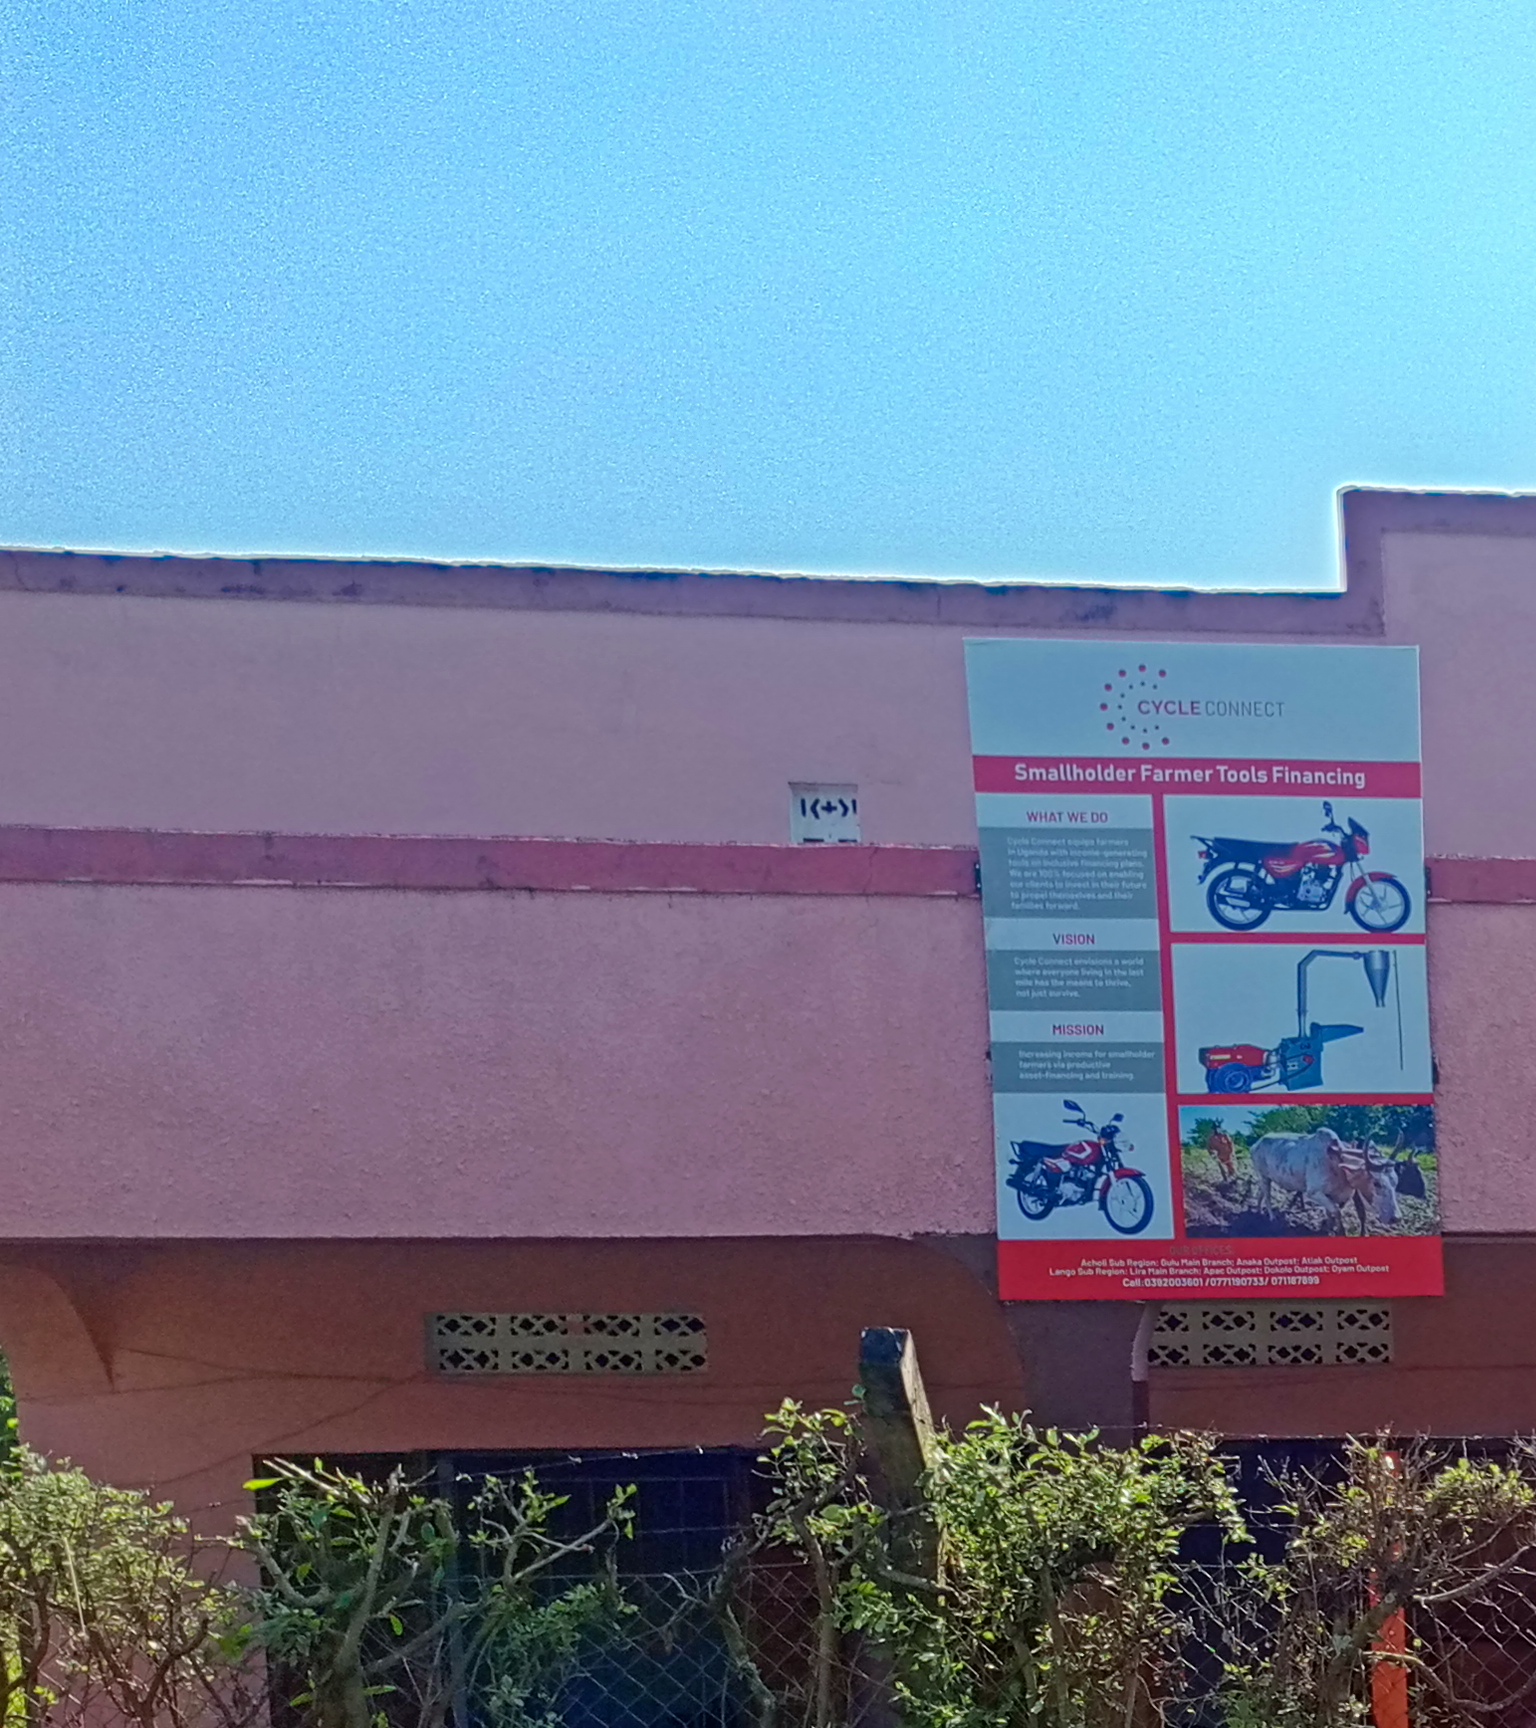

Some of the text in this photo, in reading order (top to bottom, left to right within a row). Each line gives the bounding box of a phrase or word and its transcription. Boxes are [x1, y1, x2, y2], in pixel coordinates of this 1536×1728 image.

[1138, 700, 1285, 717] CYCLE CONNECT
[1015, 763, 1365, 789] Smallholder Farmer Tools Financing
[1027, 811, 1108, 823] WHAT WE DO
[1053, 933, 1095, 945] VISION
[1052, 1024, 1104, 1035] MISSION
